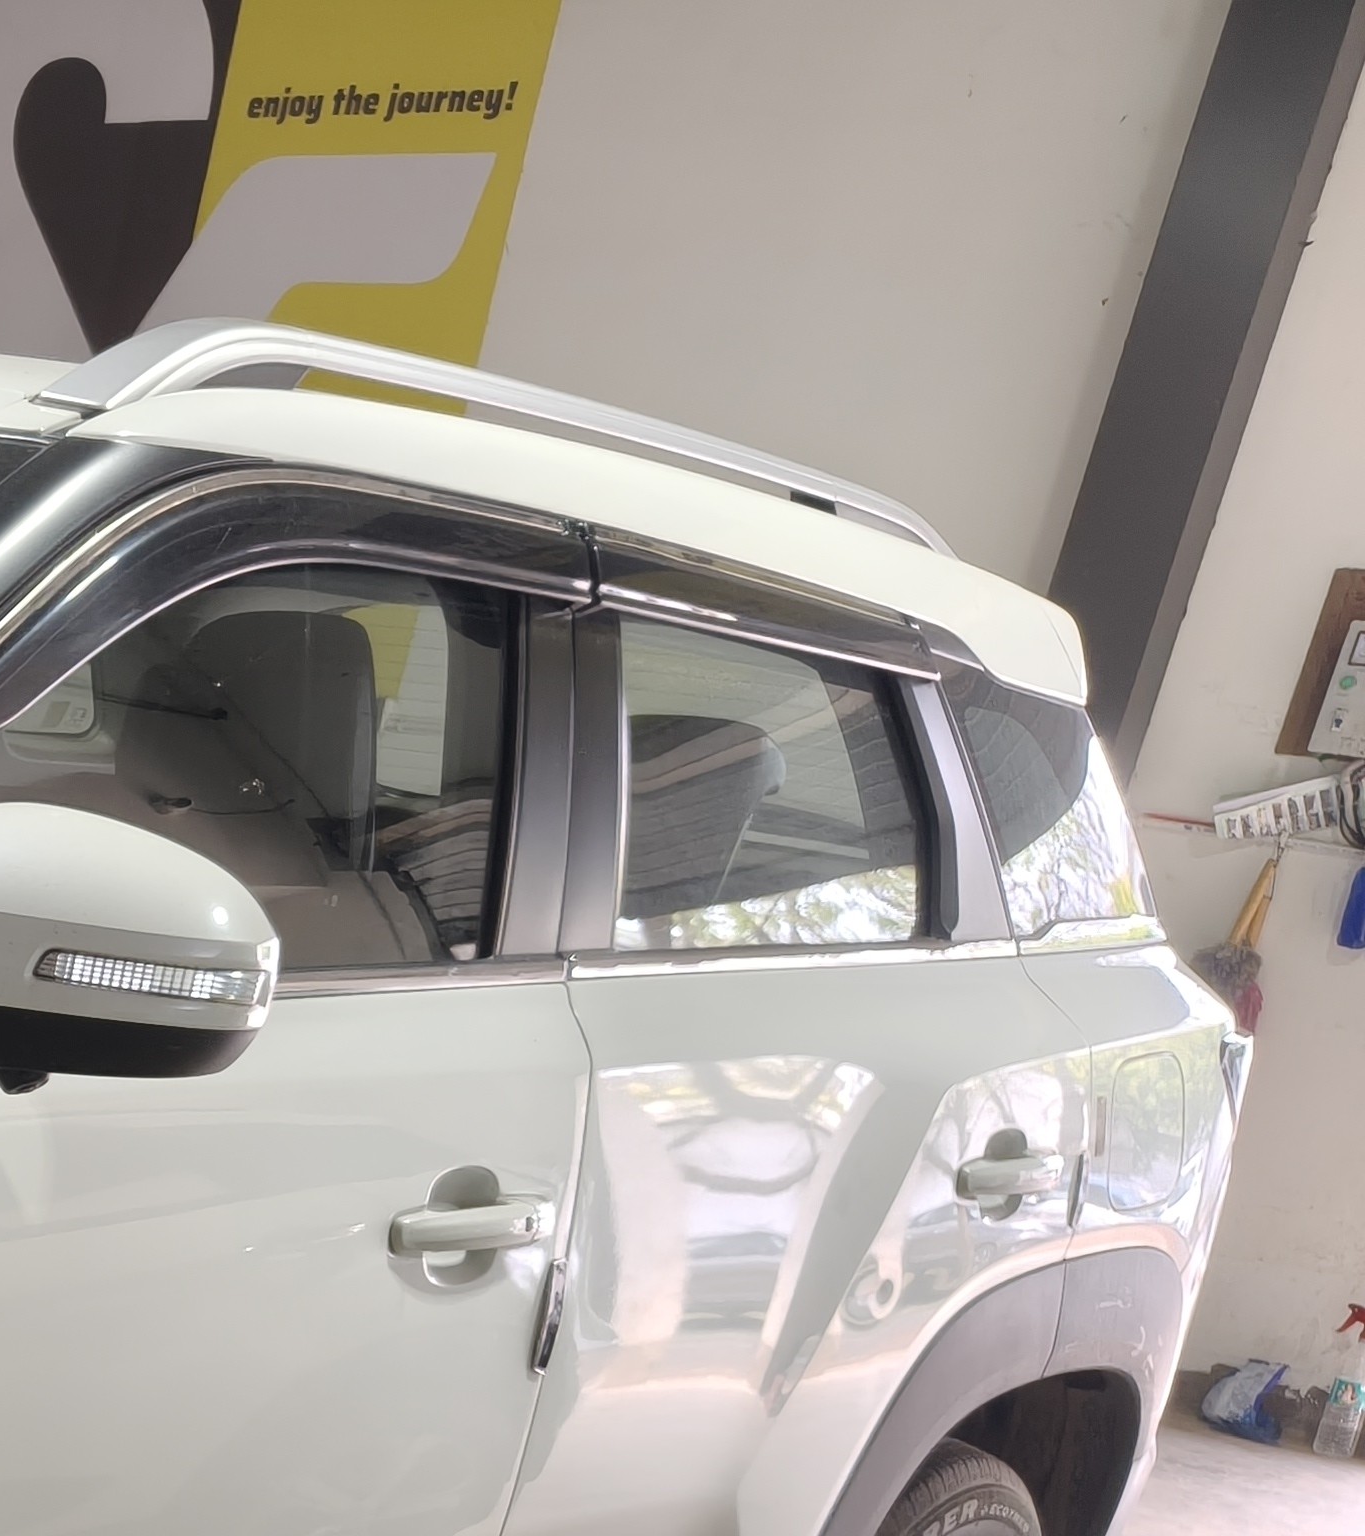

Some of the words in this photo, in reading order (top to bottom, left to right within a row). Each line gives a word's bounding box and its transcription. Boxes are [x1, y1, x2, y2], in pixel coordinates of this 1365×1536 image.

[247, 87, 325, 124] enjoy
[332, 84, 380, 116] the
[383, 81, 519, 122] journey!
